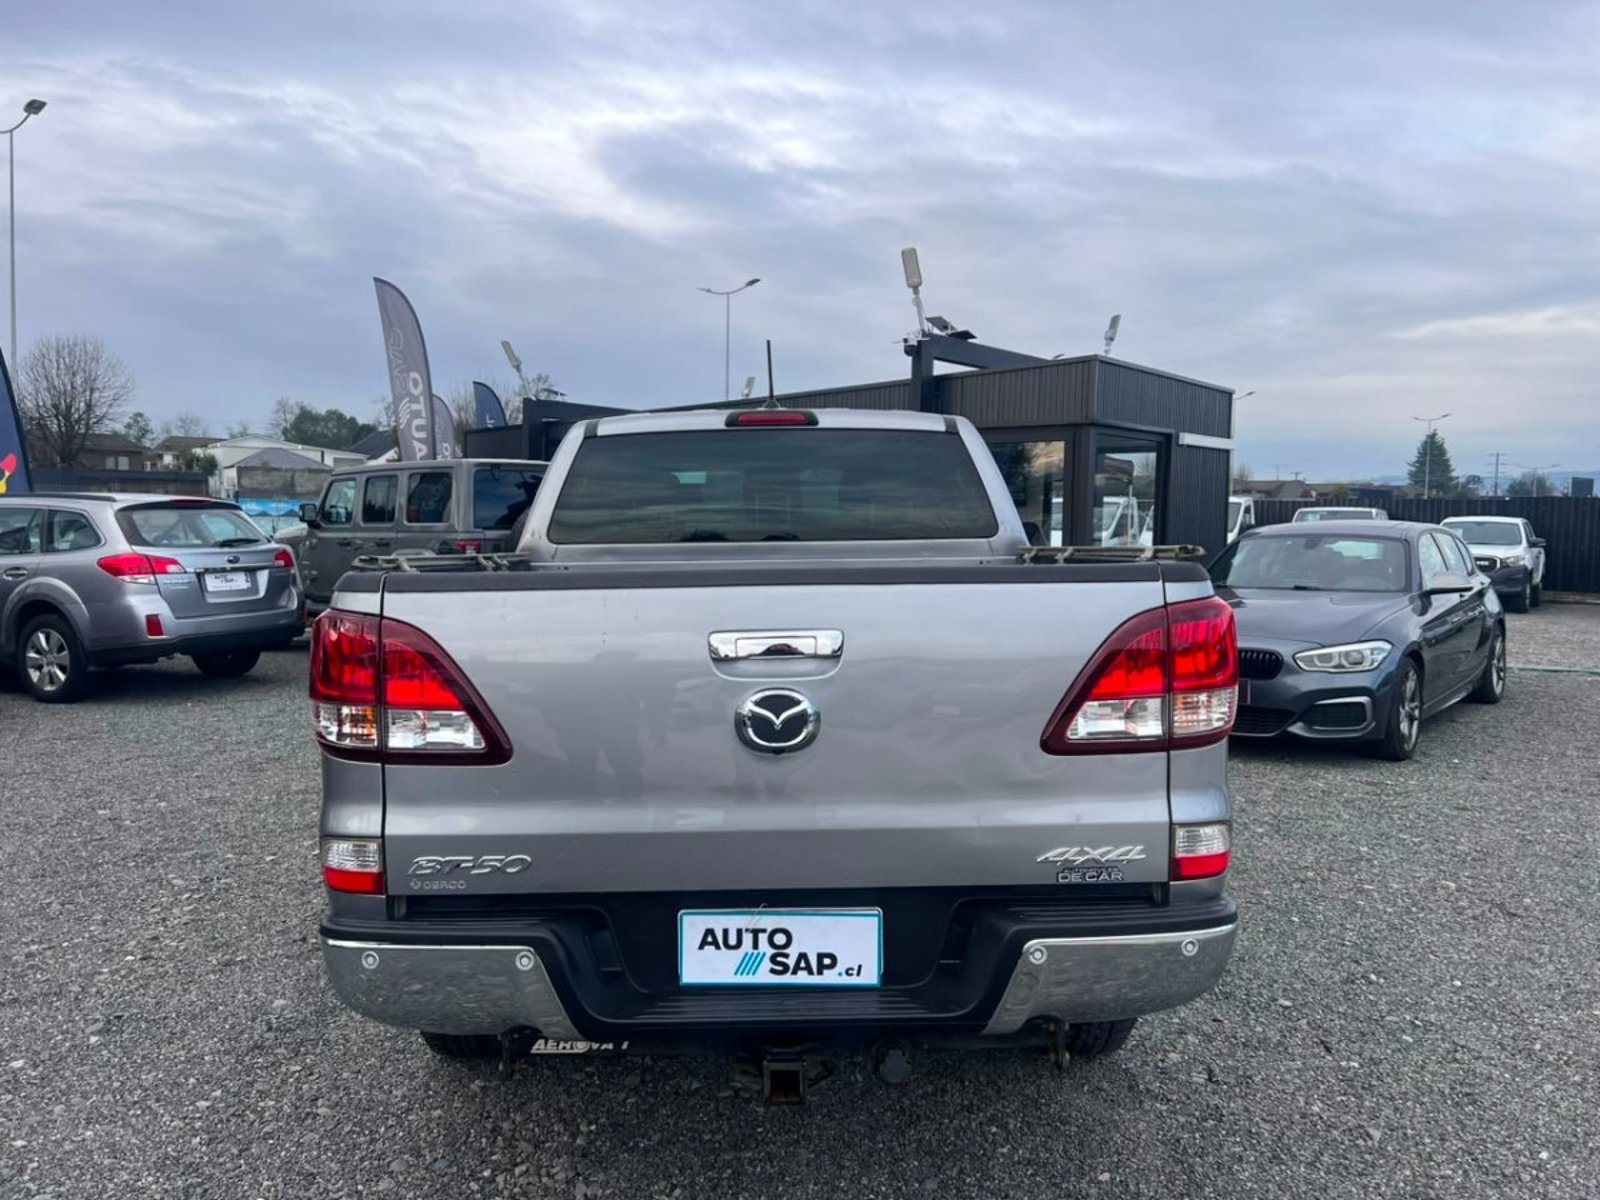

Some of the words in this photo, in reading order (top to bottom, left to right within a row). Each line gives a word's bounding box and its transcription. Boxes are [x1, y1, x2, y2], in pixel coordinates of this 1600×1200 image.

[408, 854, 532, 875] BT-50
[1085, 871, 1123, 881] CAR
[697, 927, 793, 951] AUTO
[768, 951, 863, 977] SAP.cl
